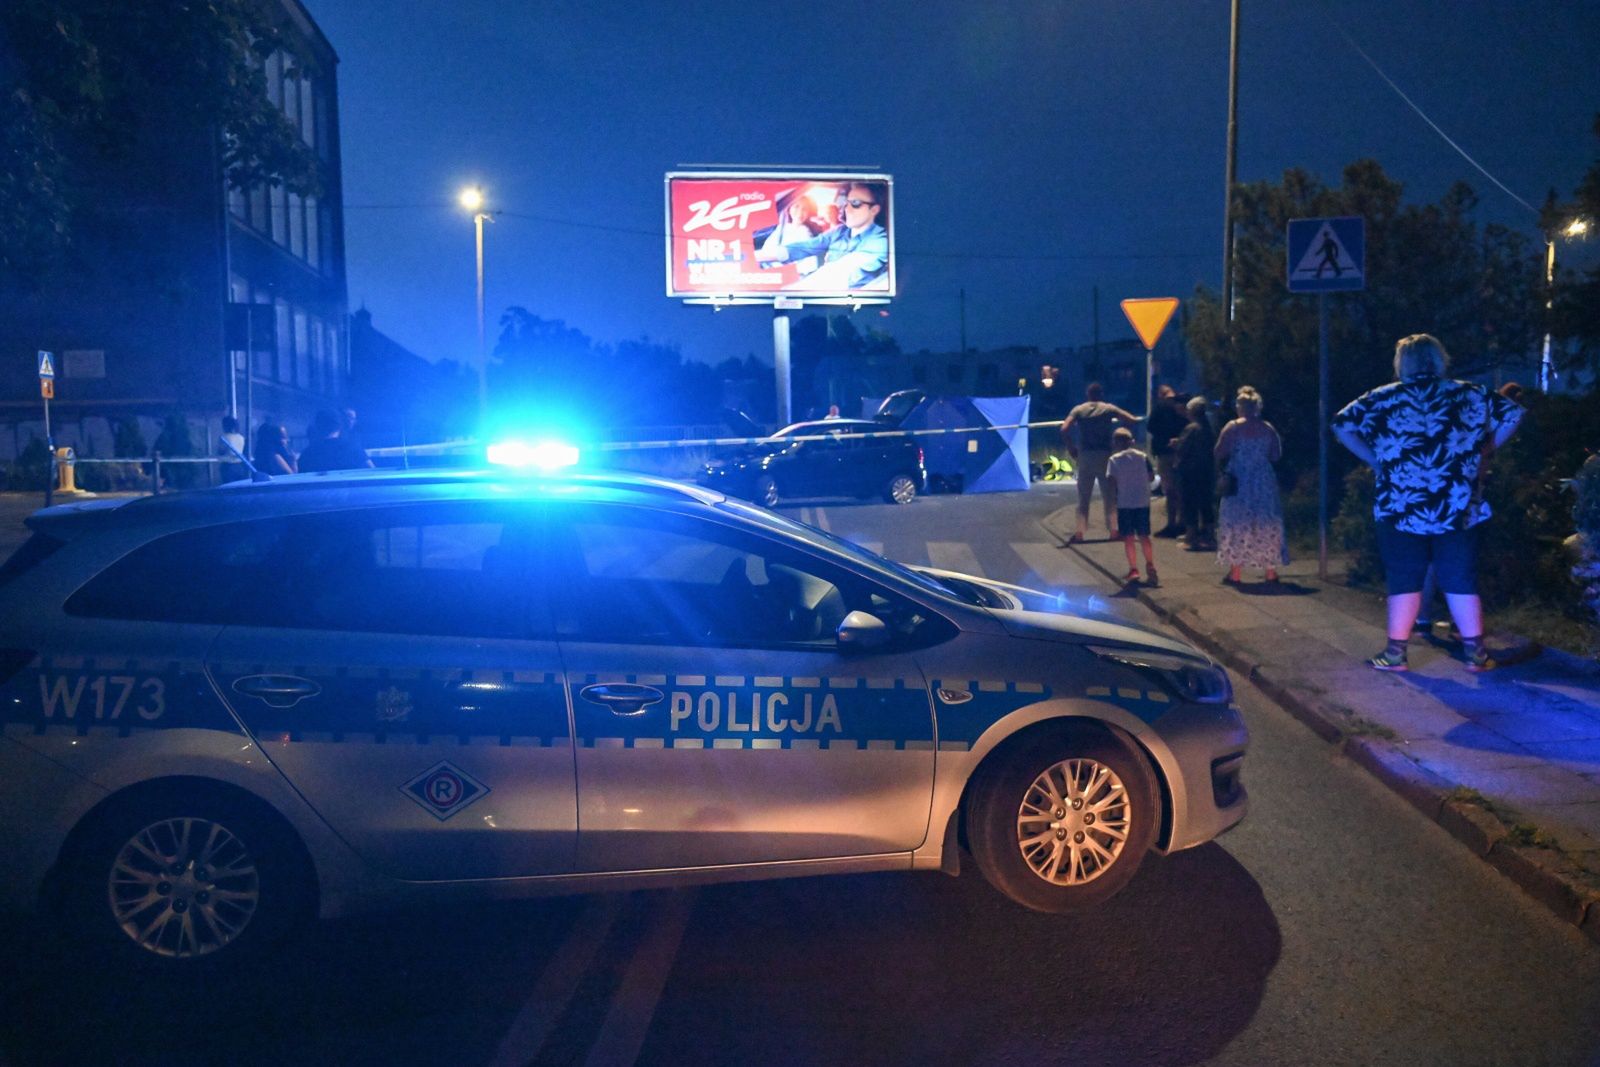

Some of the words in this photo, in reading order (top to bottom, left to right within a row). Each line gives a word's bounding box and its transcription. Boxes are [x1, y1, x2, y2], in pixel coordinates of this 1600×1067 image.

[740, 191, 765, 201] radio
[687, 239, 726, 260] NR
[730, 239, 741, 260] 1
[39, 675, 166, 719] W173
[670, 691, 842, 732] POLICJA
[435, 780, 452, 798] R
